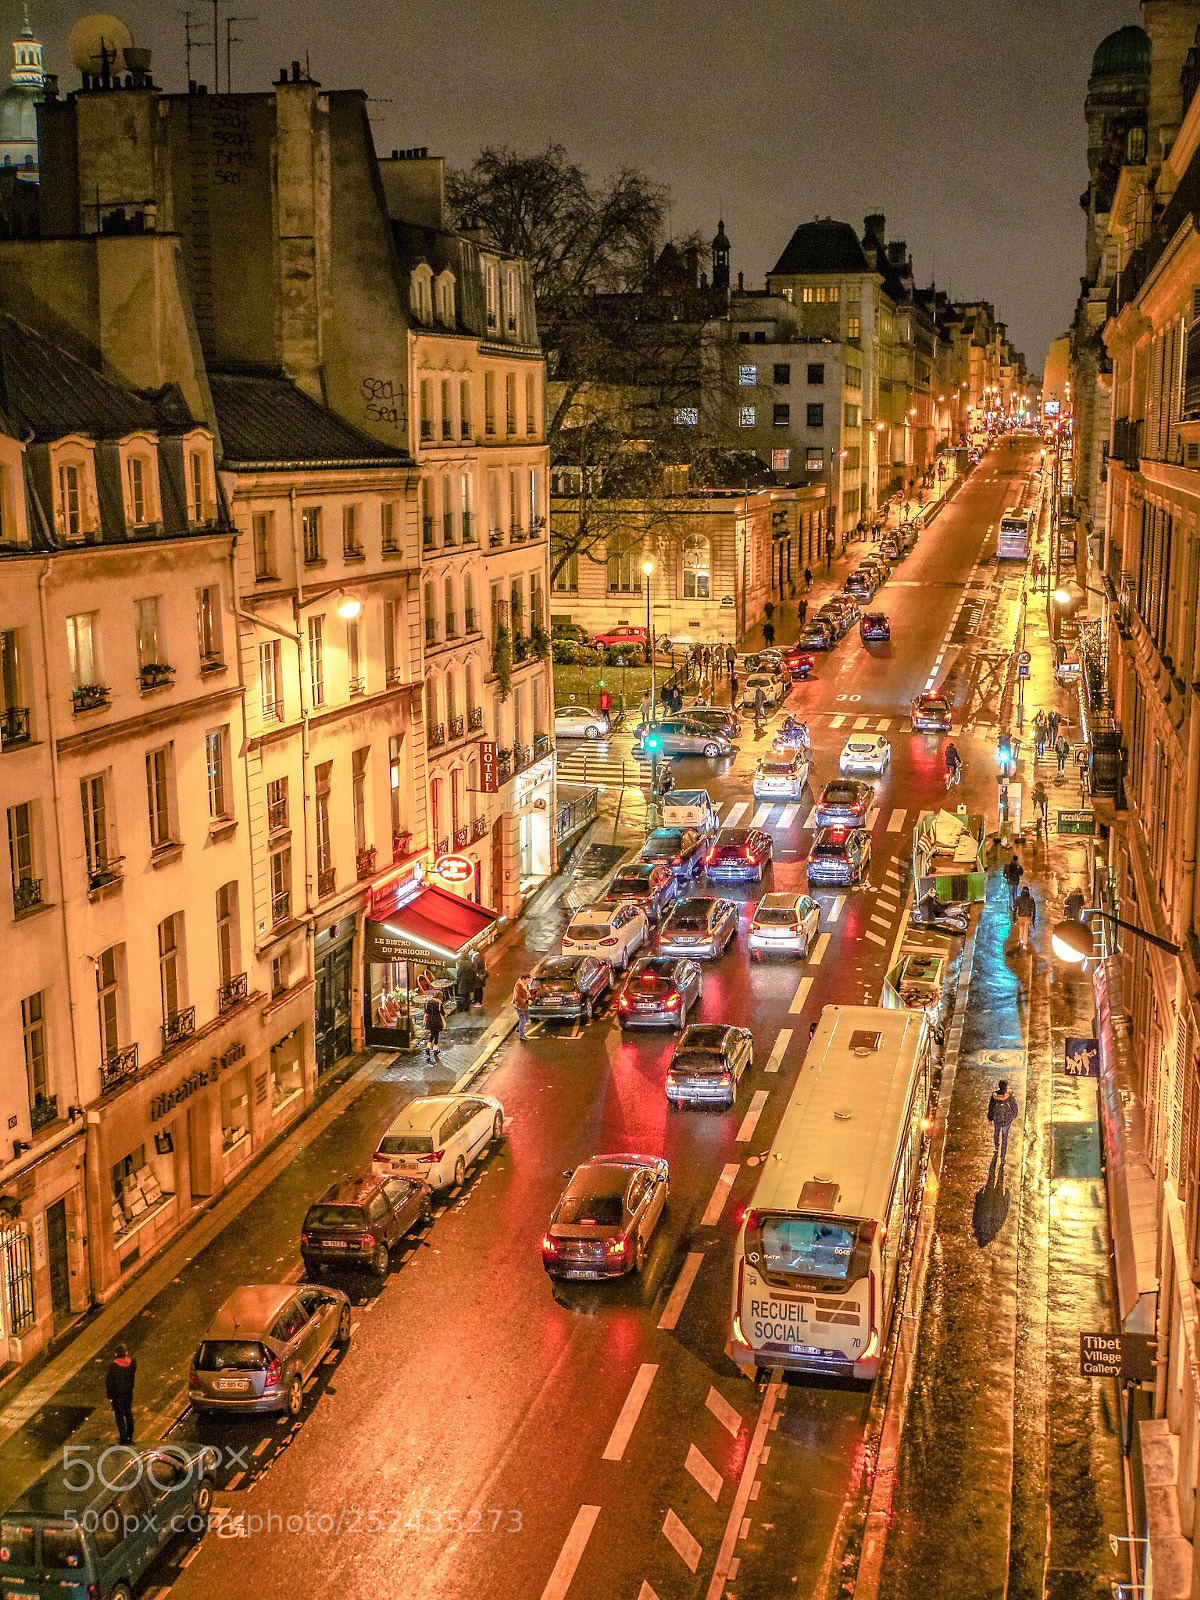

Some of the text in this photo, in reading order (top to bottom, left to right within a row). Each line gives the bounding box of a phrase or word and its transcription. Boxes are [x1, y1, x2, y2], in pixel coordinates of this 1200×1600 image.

[484, 743, 493, 792] HOTEL
[385, 938, 411, 947] BISTRO
[751, 1300, 809, 1323] RECUEIL
[754, 1321, 804, 1343] SOCIAL
[852, 1337, 861, 1348] 70
[1083, 1336, 1122, 1350] Tibet
[1083, 1350, 1122, 1364] Village
[1083, 1362, 1122, 1376] Gallery
